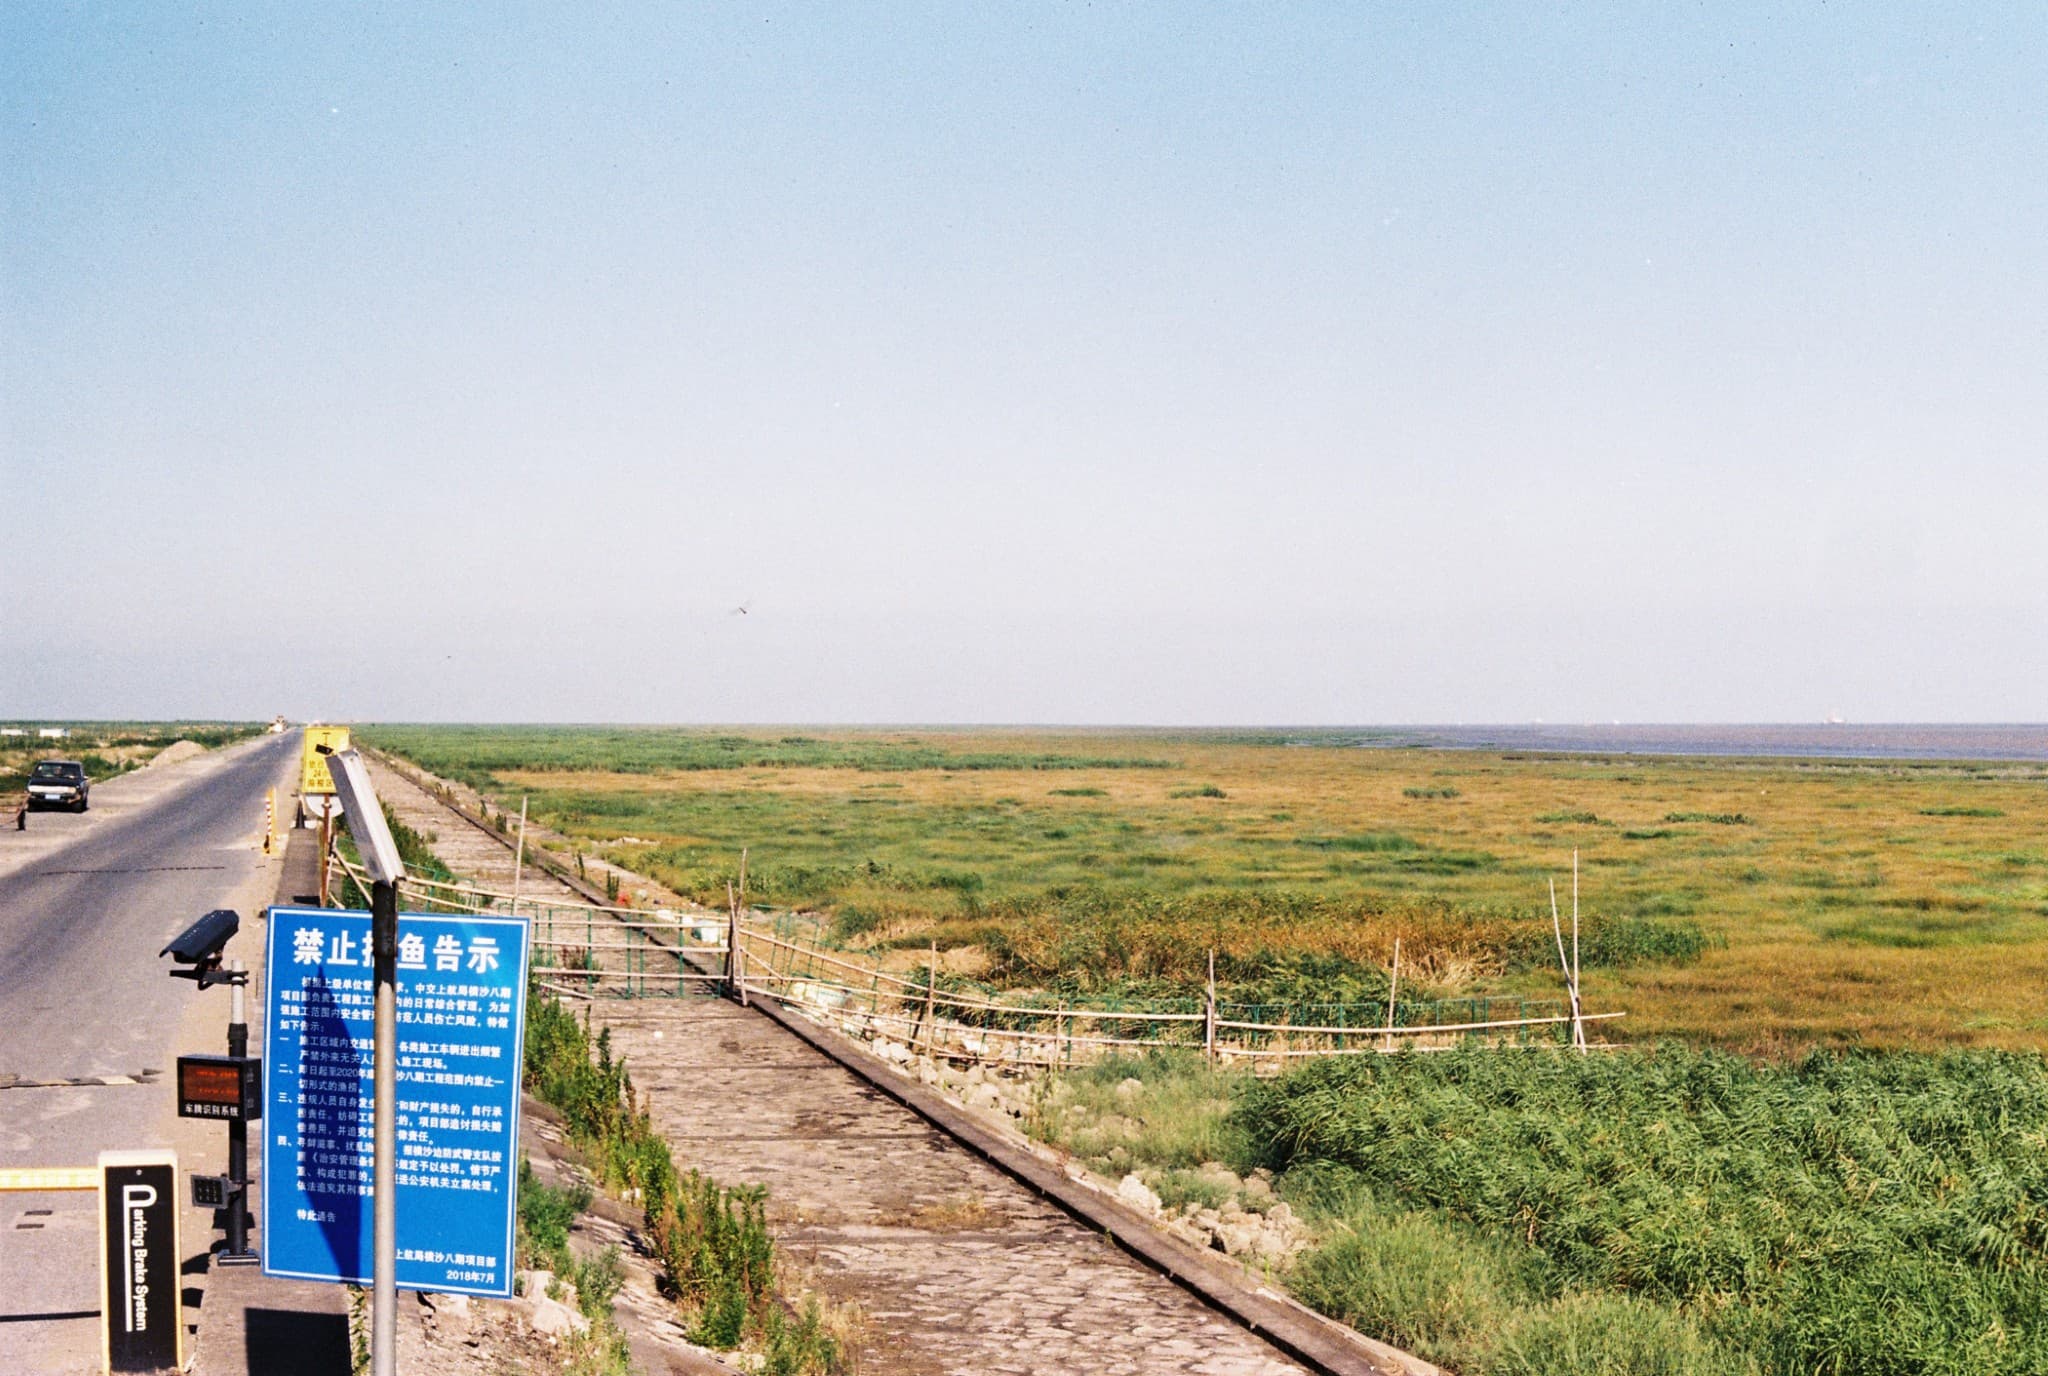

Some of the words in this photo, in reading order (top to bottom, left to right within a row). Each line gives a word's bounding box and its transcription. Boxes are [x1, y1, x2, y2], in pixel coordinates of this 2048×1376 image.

[185, 1103, 239, 1117] 车牌识别系统
[133, 1248, 148, 1284] Brake
[446, 1269, 496, 1284] 2018年7月
[132, 1285, 149, 1332] System
